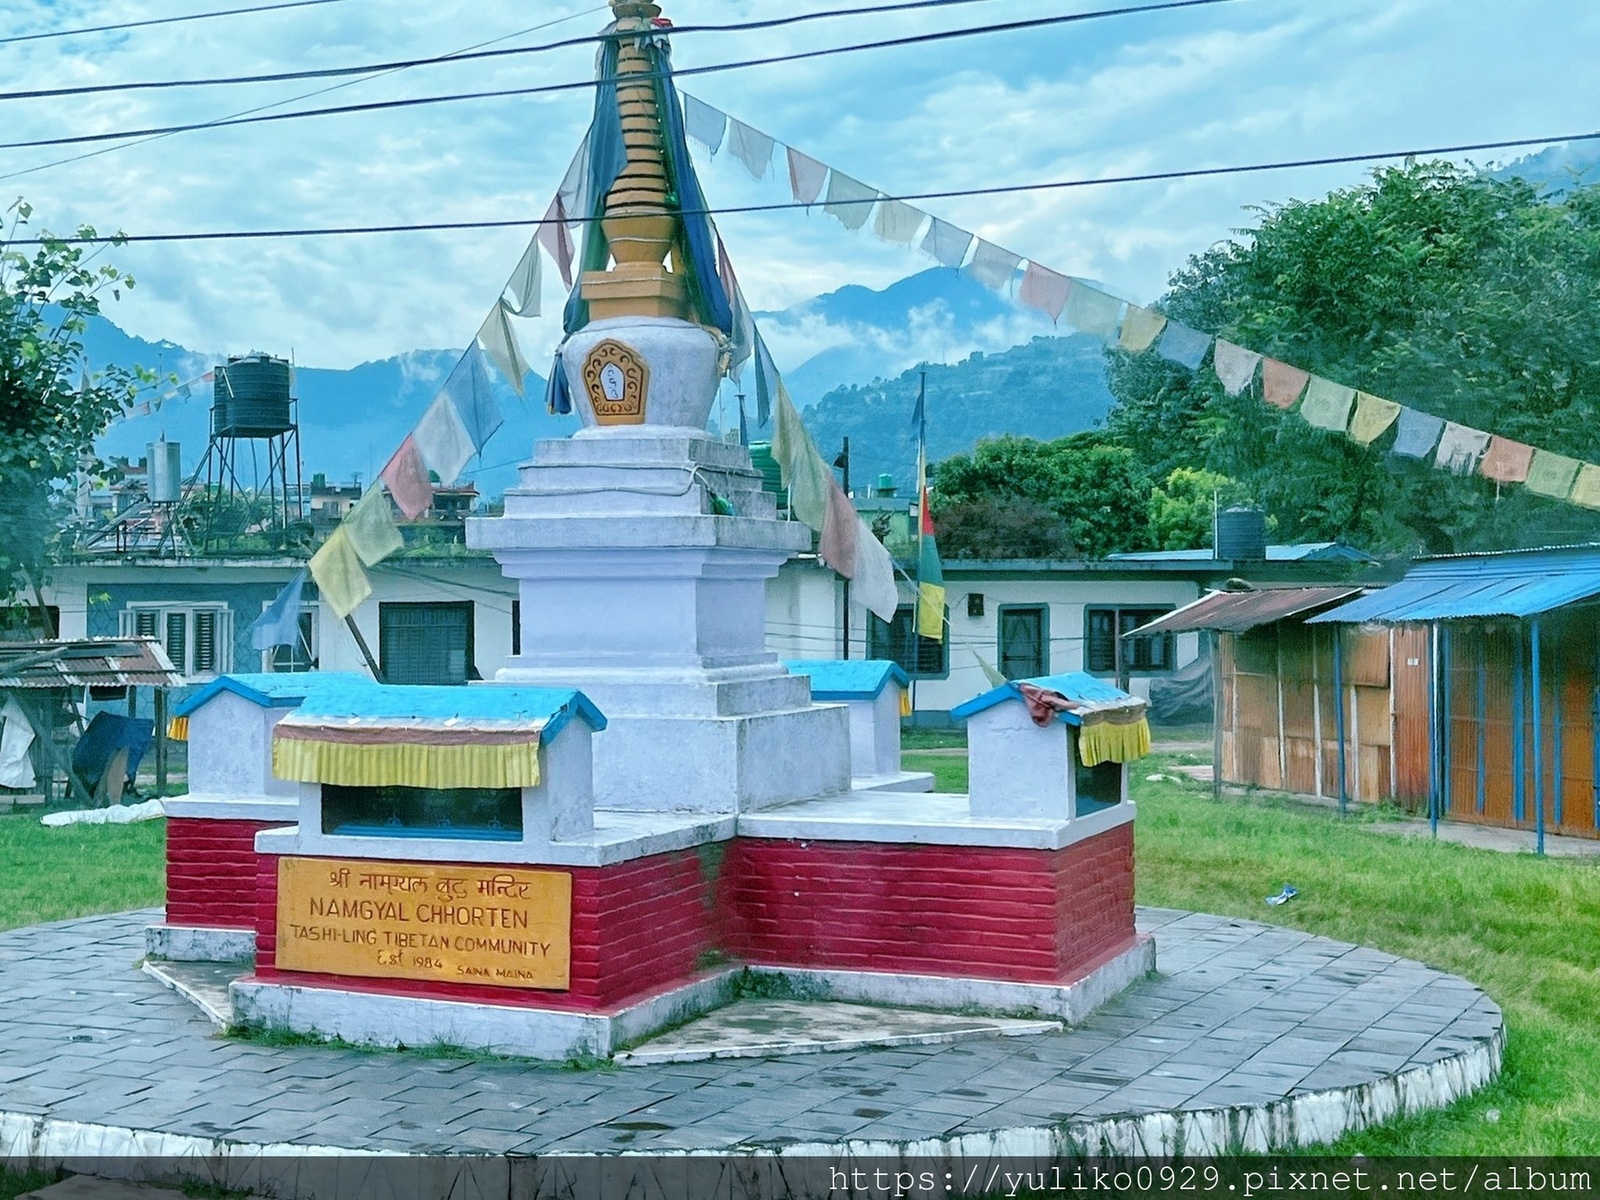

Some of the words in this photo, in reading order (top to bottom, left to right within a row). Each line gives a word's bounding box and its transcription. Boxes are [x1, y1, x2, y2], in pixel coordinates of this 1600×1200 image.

[329, 867, 351, 889] श्री
[476, 873, 533, 900] मन्दिर
[309, 897, 411, 922] NAMGYAL
[416, 904, 529, 930] CHHORTEN
[289, 923, 378, 945] TASHI-LING
[383, 930, 450, 949] TIBETAN
[454, 935, 552, 957] COMMUNITY
[412, 956, 443, 969] 1984
